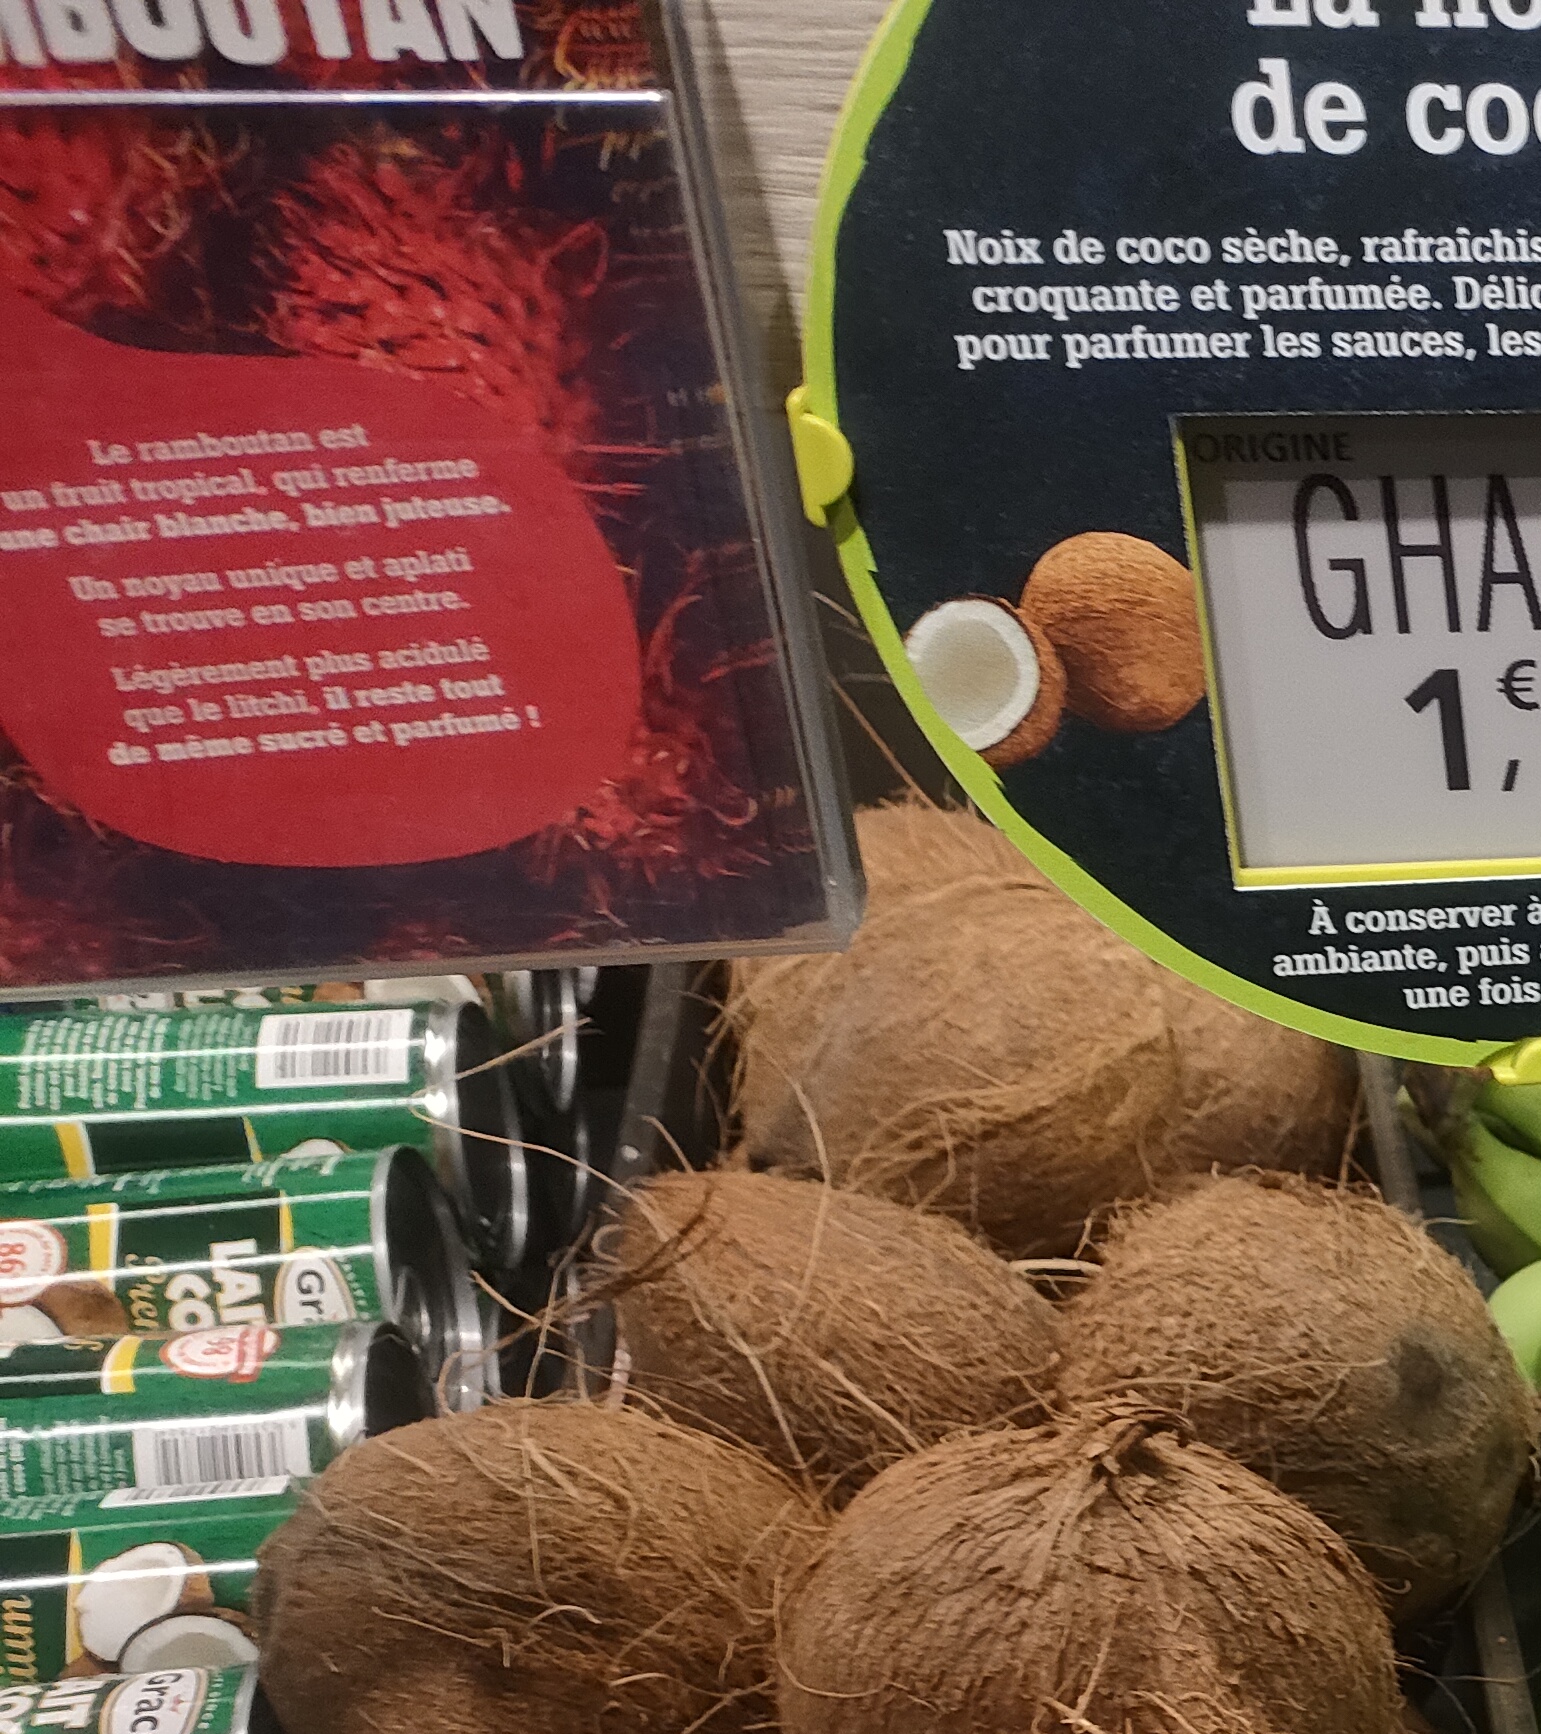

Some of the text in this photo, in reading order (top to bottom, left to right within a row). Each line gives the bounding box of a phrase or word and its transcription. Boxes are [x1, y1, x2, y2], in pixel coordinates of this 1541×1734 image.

[1230, 59, 1367, 157] de
[944, 230, 1044, 267] Noix
[1053, 230, 1104, 265] de
[1115, 237, 1211, 266] coco
[1222, 230, 1350, 270] sèche,
[972, 279, 1181, 321] croquante
[1192, 279, 1230, 312] et
[1242, 275, 1443, 319] parfumée.
[955, 331, 1051, 369] pour
[1065, 323, 1253, 368] parfumer
[1262, 323, 1322, 360] les
[1331, 330, 1476, 364] sauces,
[87, 424, 370, 465] Le ramboutan est
[1191, 431, 1354, 463] ORIGINE
[51, 477, 126, 509] fruit
[273, 464, 329, 496] qui
[334, 457, 480, 488] renferme
[64, 493, 512, 547] chair blanche, bien juteuse.
[67, 547, 474, 602] Un noyau unique et aplati
[98, 587, 471, 637] se trouve en son centre.
[110, 637, 490, 694] Légèrement plus acidulé
[123, 673, 506, 734] que le litchi, il reste tout
[107, 707, 522, 767] de même sucré et parfumé
[1308, 898, 1337, 936] À
[1345, 903, 1518, 936] conserver
[1272, 946, 1449, 977] ambiante,
[1456, 939, 1531, 975] puis
[1403, 984, 1469, 1011] une
[1478, 975, 1541, 1005] fois
[208, 1238, 268, 1328] LAI
